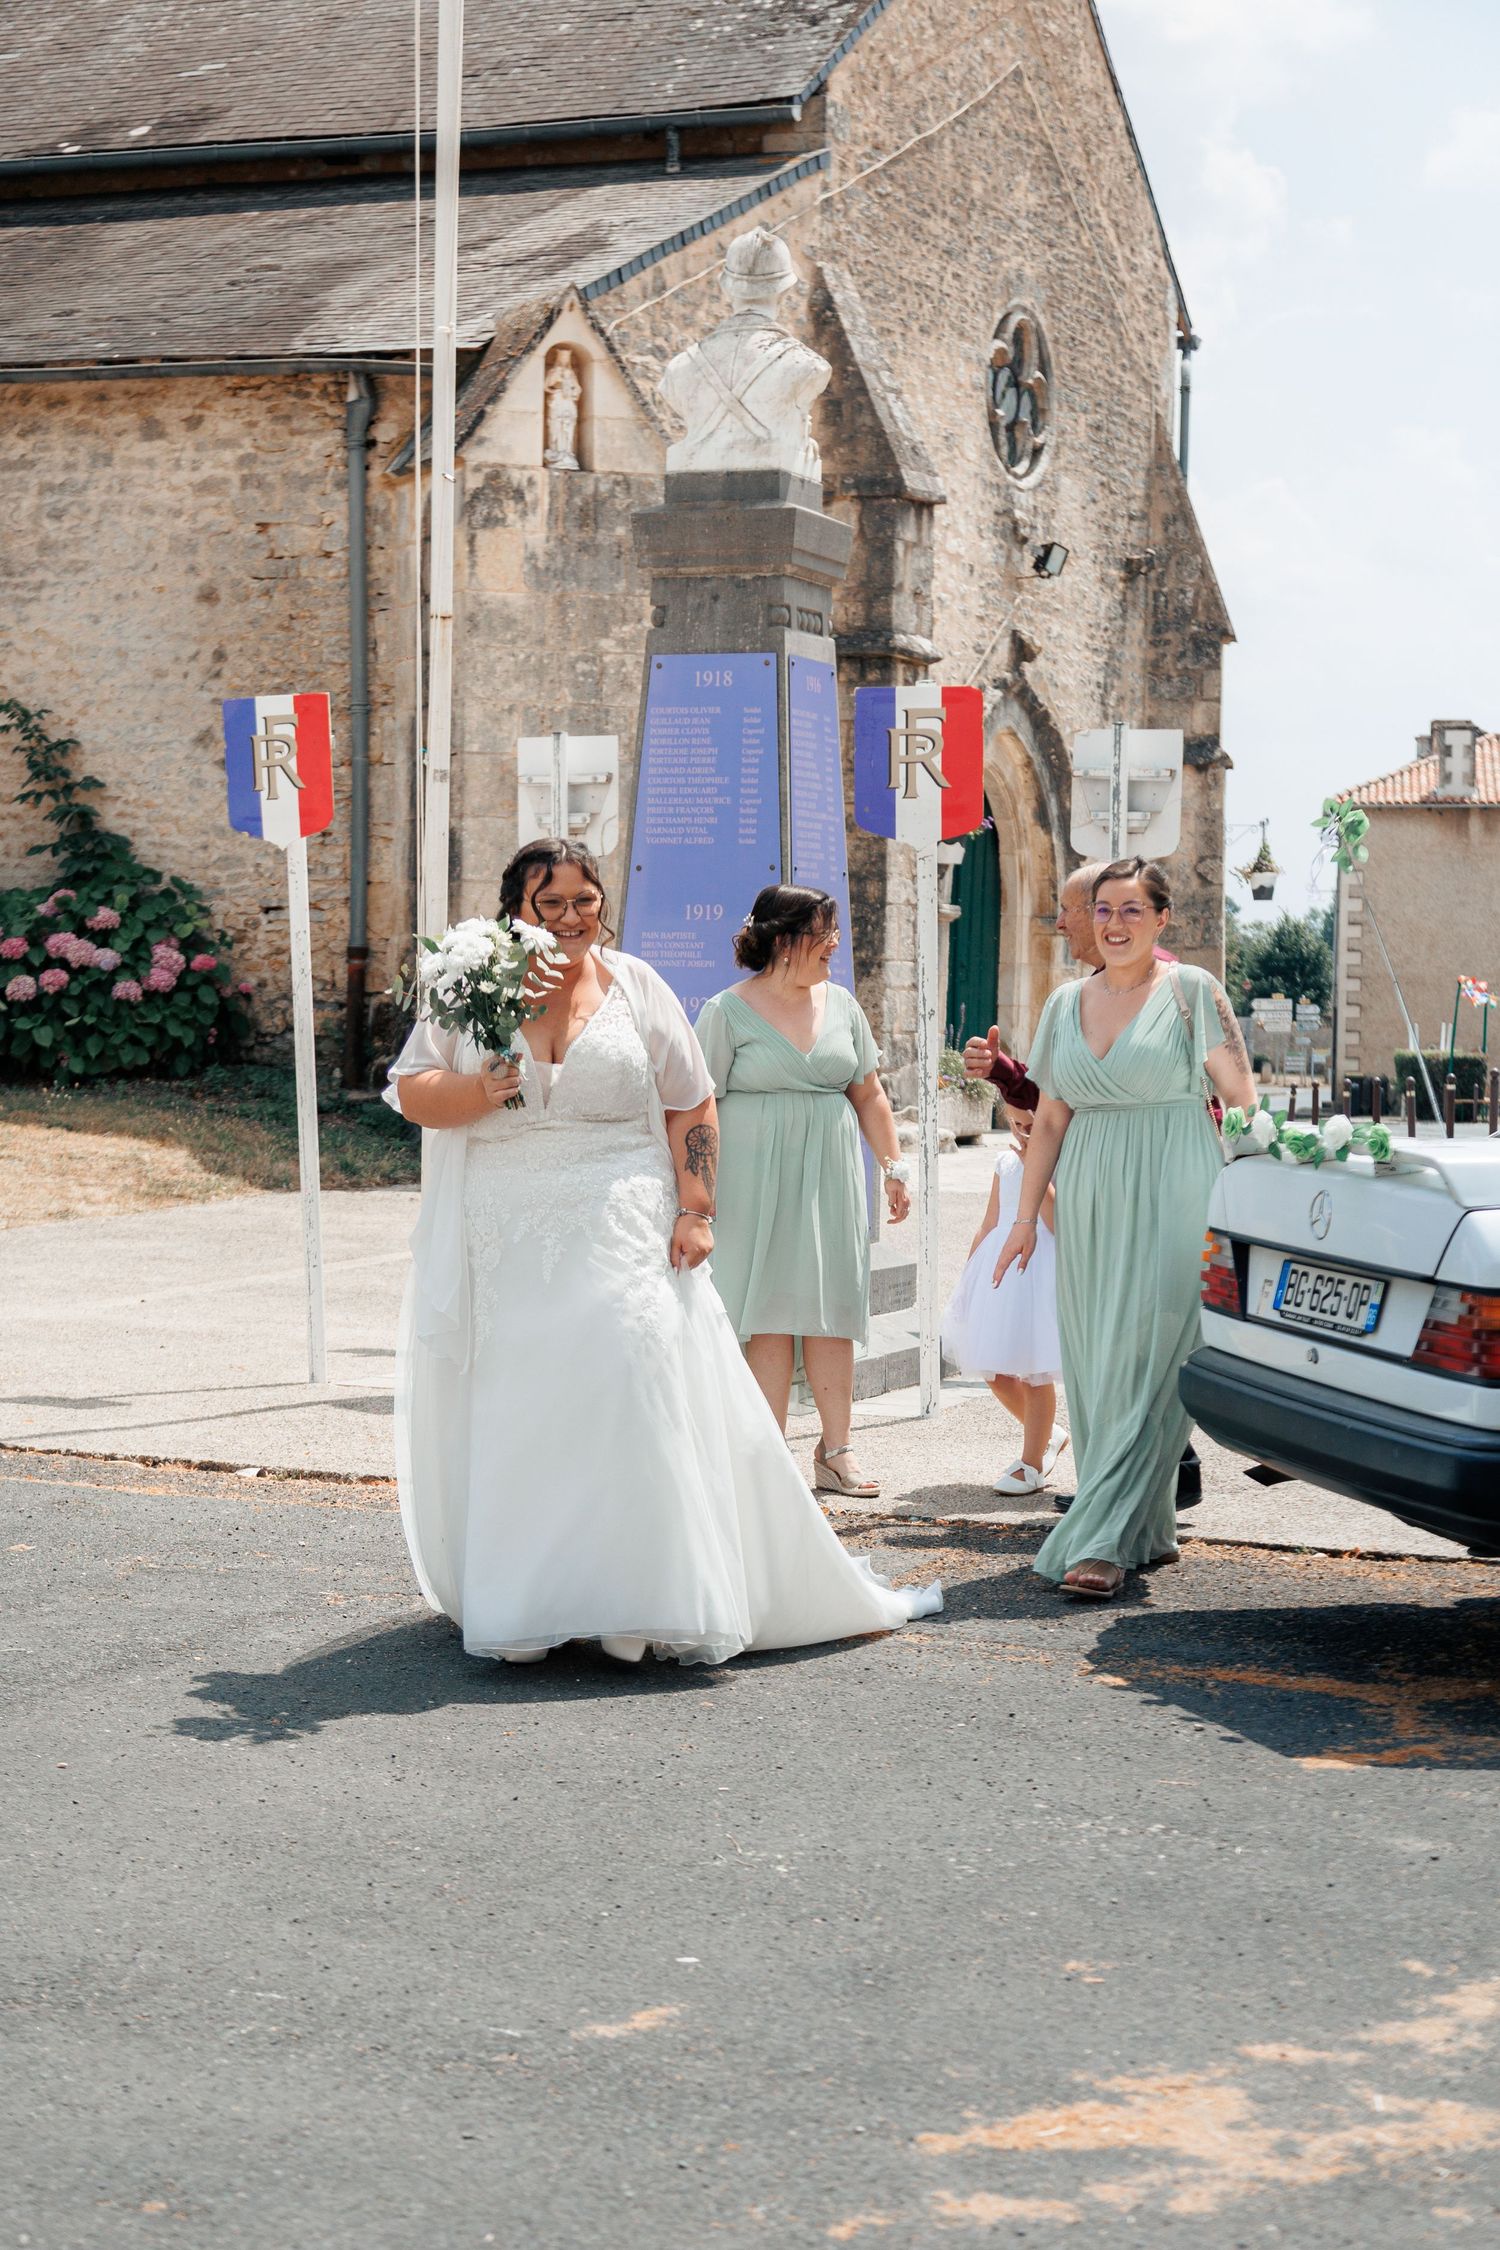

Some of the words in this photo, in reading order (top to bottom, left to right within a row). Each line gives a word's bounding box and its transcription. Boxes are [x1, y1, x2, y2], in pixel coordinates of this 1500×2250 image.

[695, 670, 733, 688] 1918
[690, 706, 721, 714] OLIVIER
[685, 904, 724, 921] 1919
